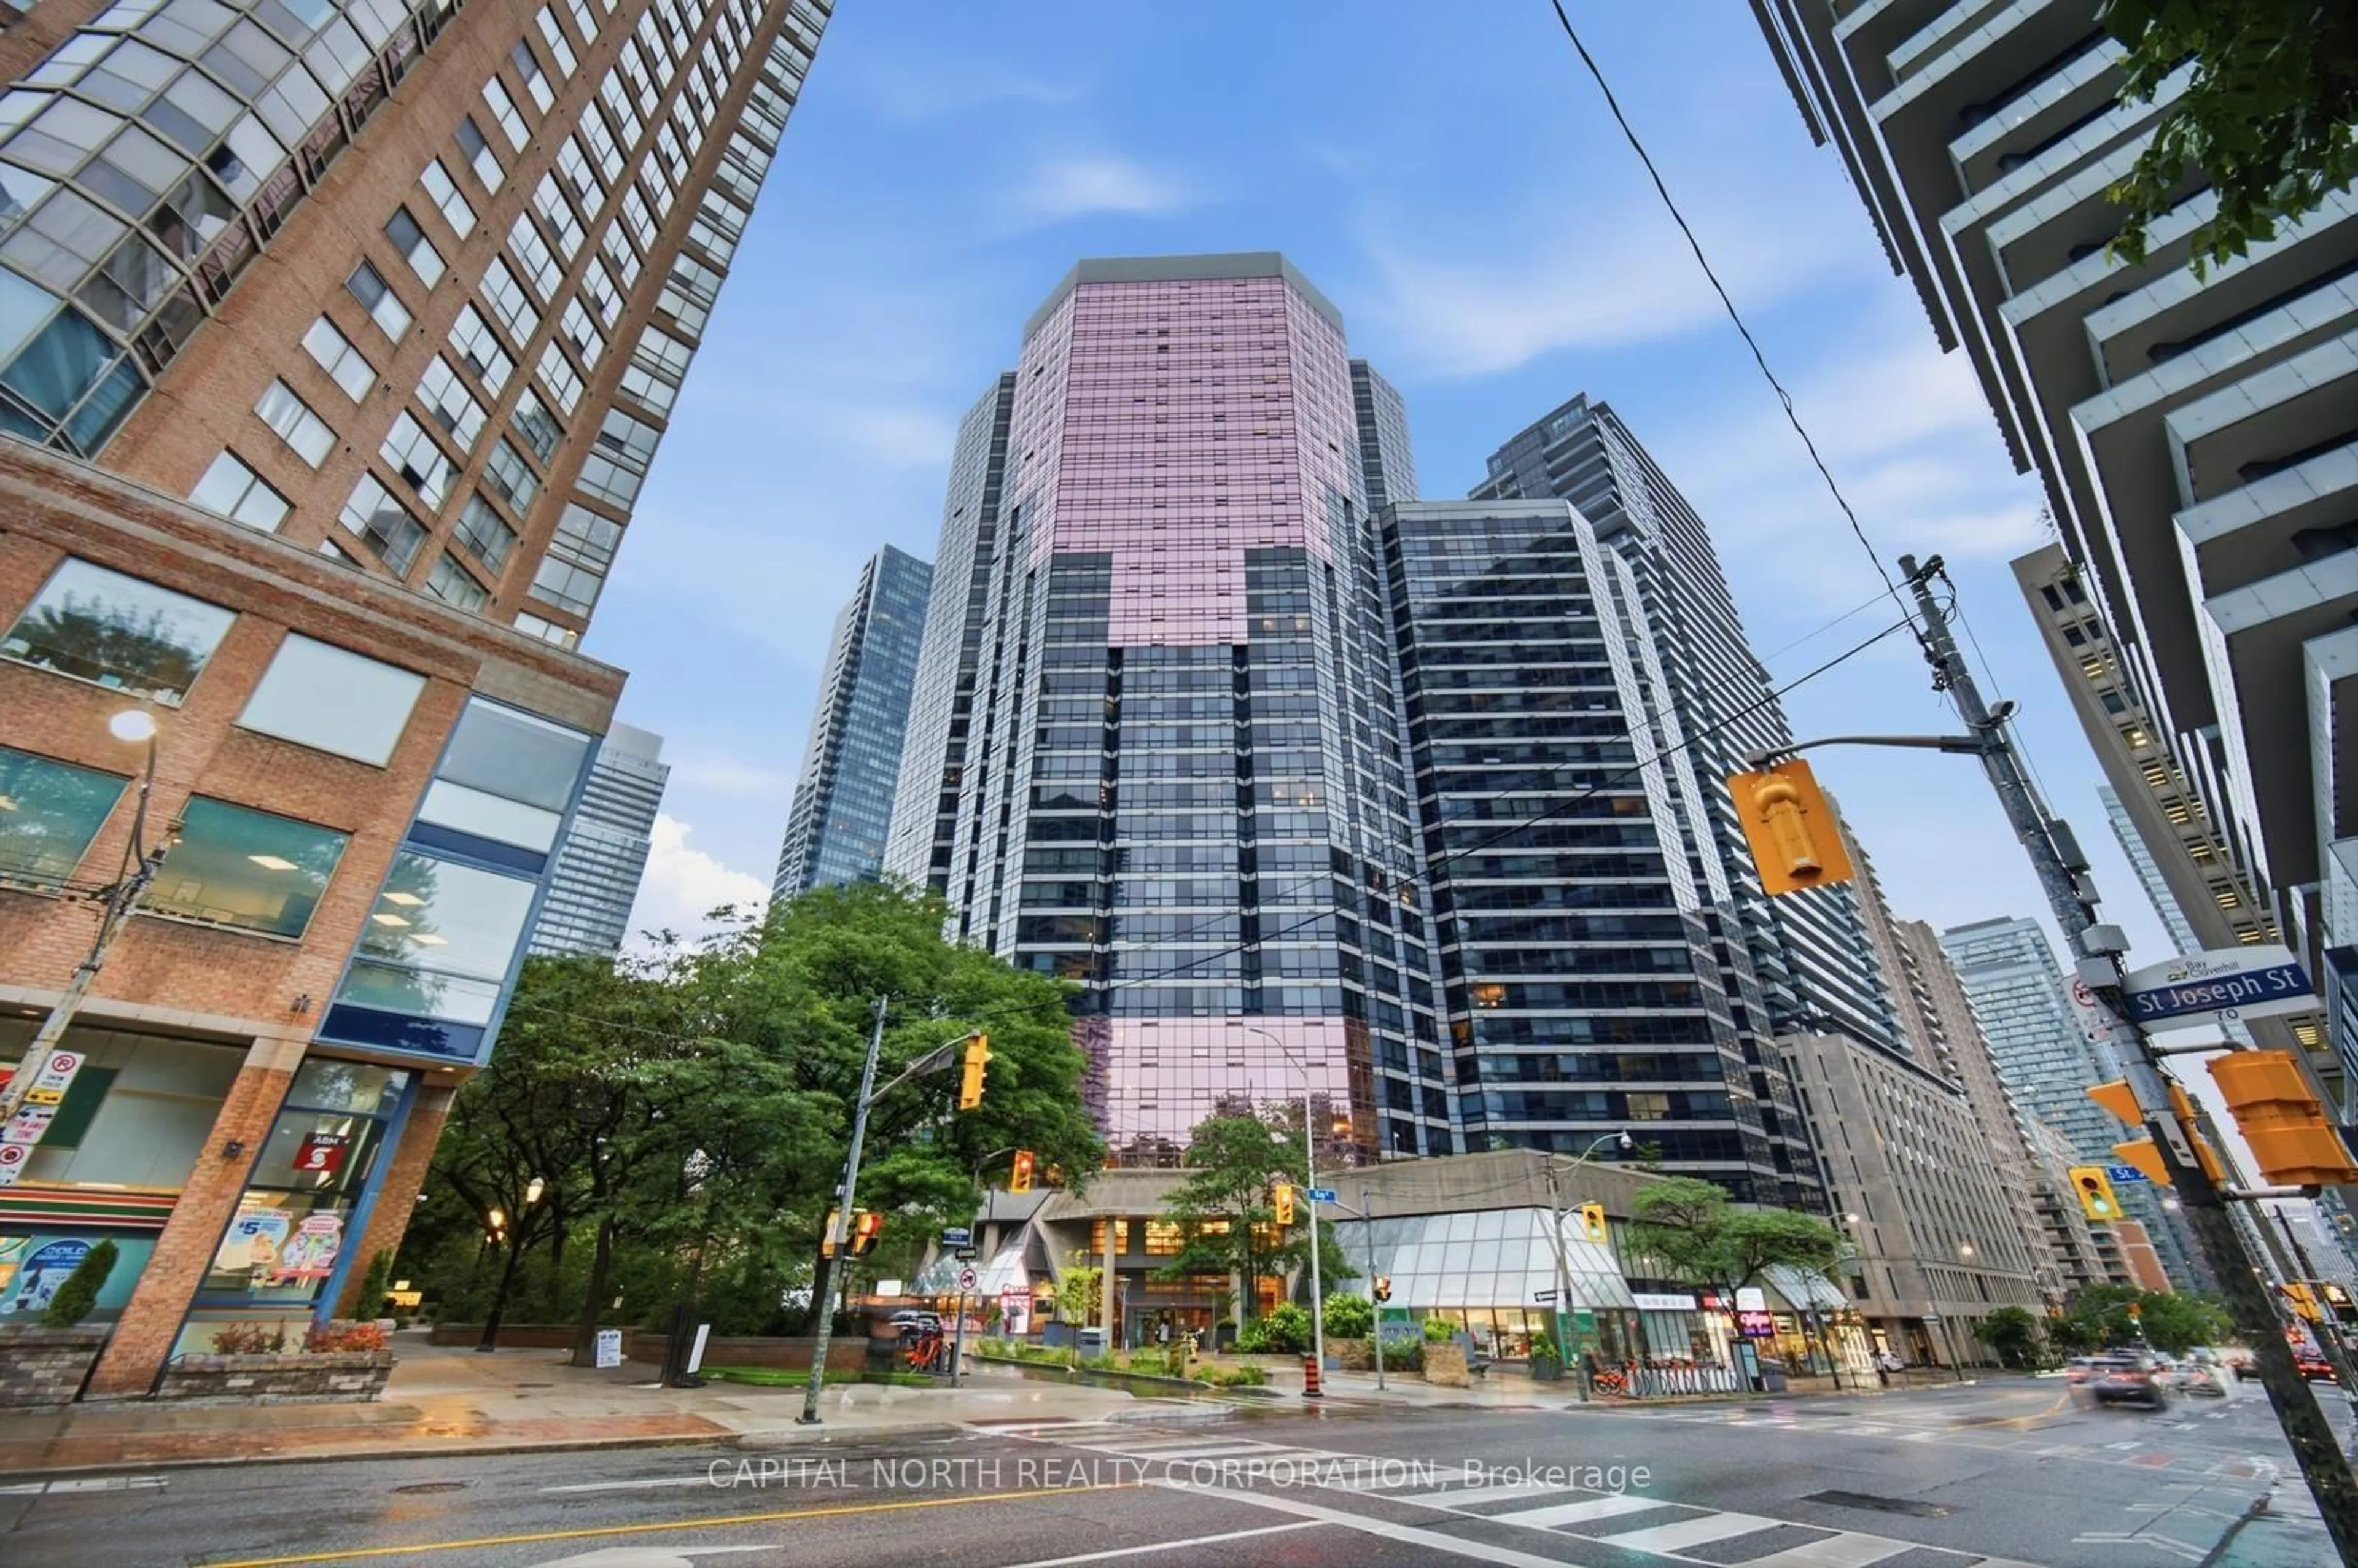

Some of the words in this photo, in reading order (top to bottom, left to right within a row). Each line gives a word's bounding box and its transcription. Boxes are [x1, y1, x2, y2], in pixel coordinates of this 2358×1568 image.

[2185, 960, 2208, 969] Bay
[2189, 961, 2241, 979] Cloverhill
[2136, 992, 2165, 1013] St
[2169, 975, 2263, 1008] Joseph
[2265, 968, 2300, 990] St
[2213, 1009, 2239, 1022] 70
